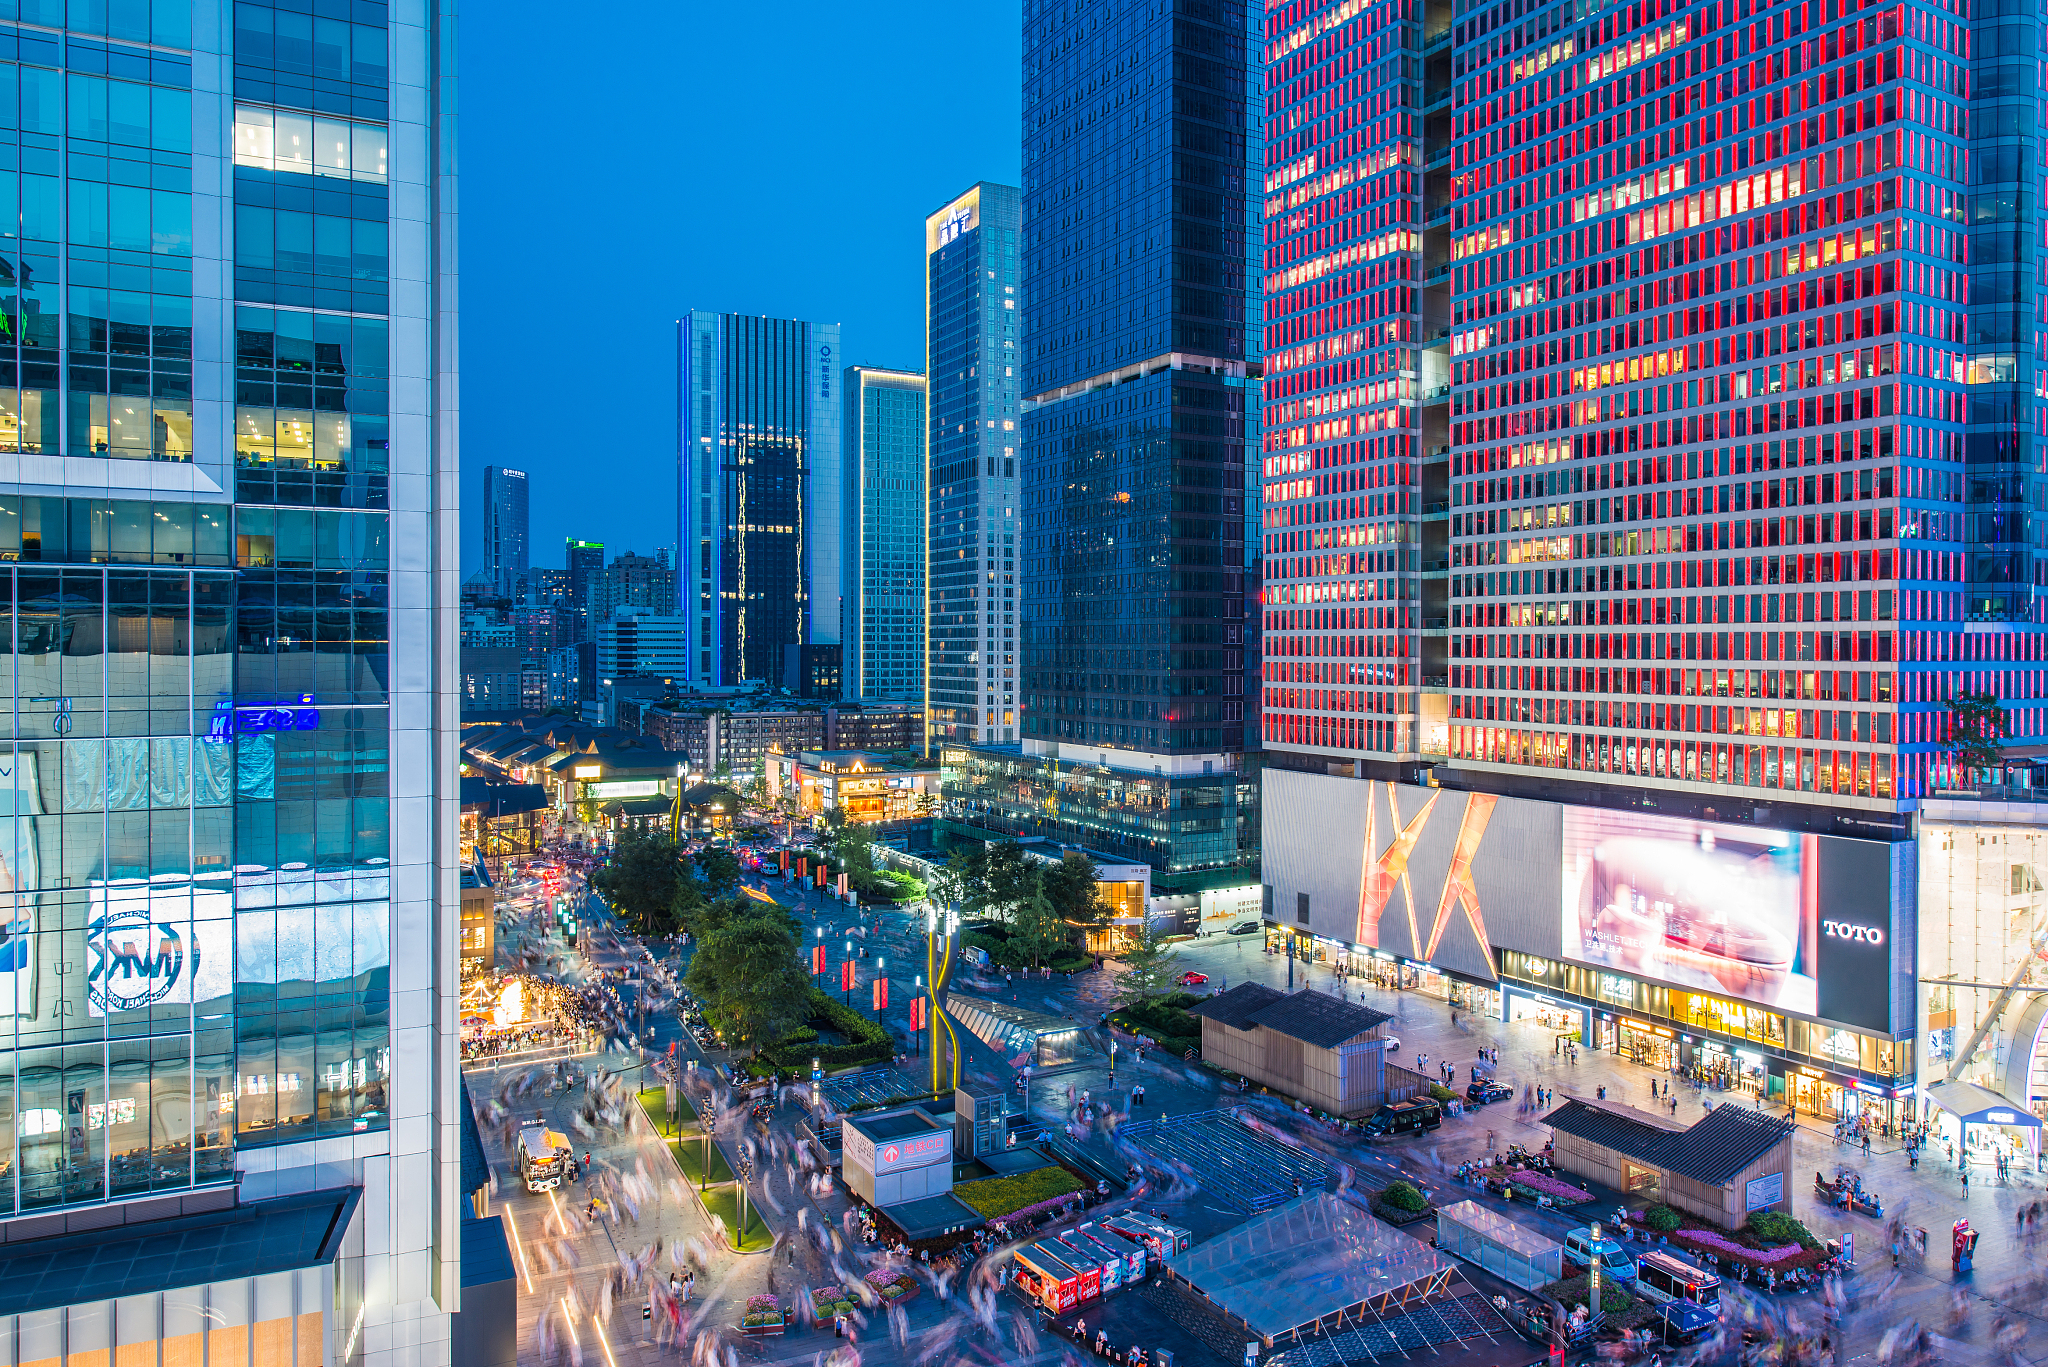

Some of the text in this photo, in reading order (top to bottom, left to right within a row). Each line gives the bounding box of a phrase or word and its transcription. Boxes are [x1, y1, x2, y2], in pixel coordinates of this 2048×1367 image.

[851, 760, 884, 774] ATRIUM
[1584, 928, 1625, 945] WASHLET
[1822, 919, 1883, 944] TOTO
[904, 1138, 944, 1155] 地铁C口
